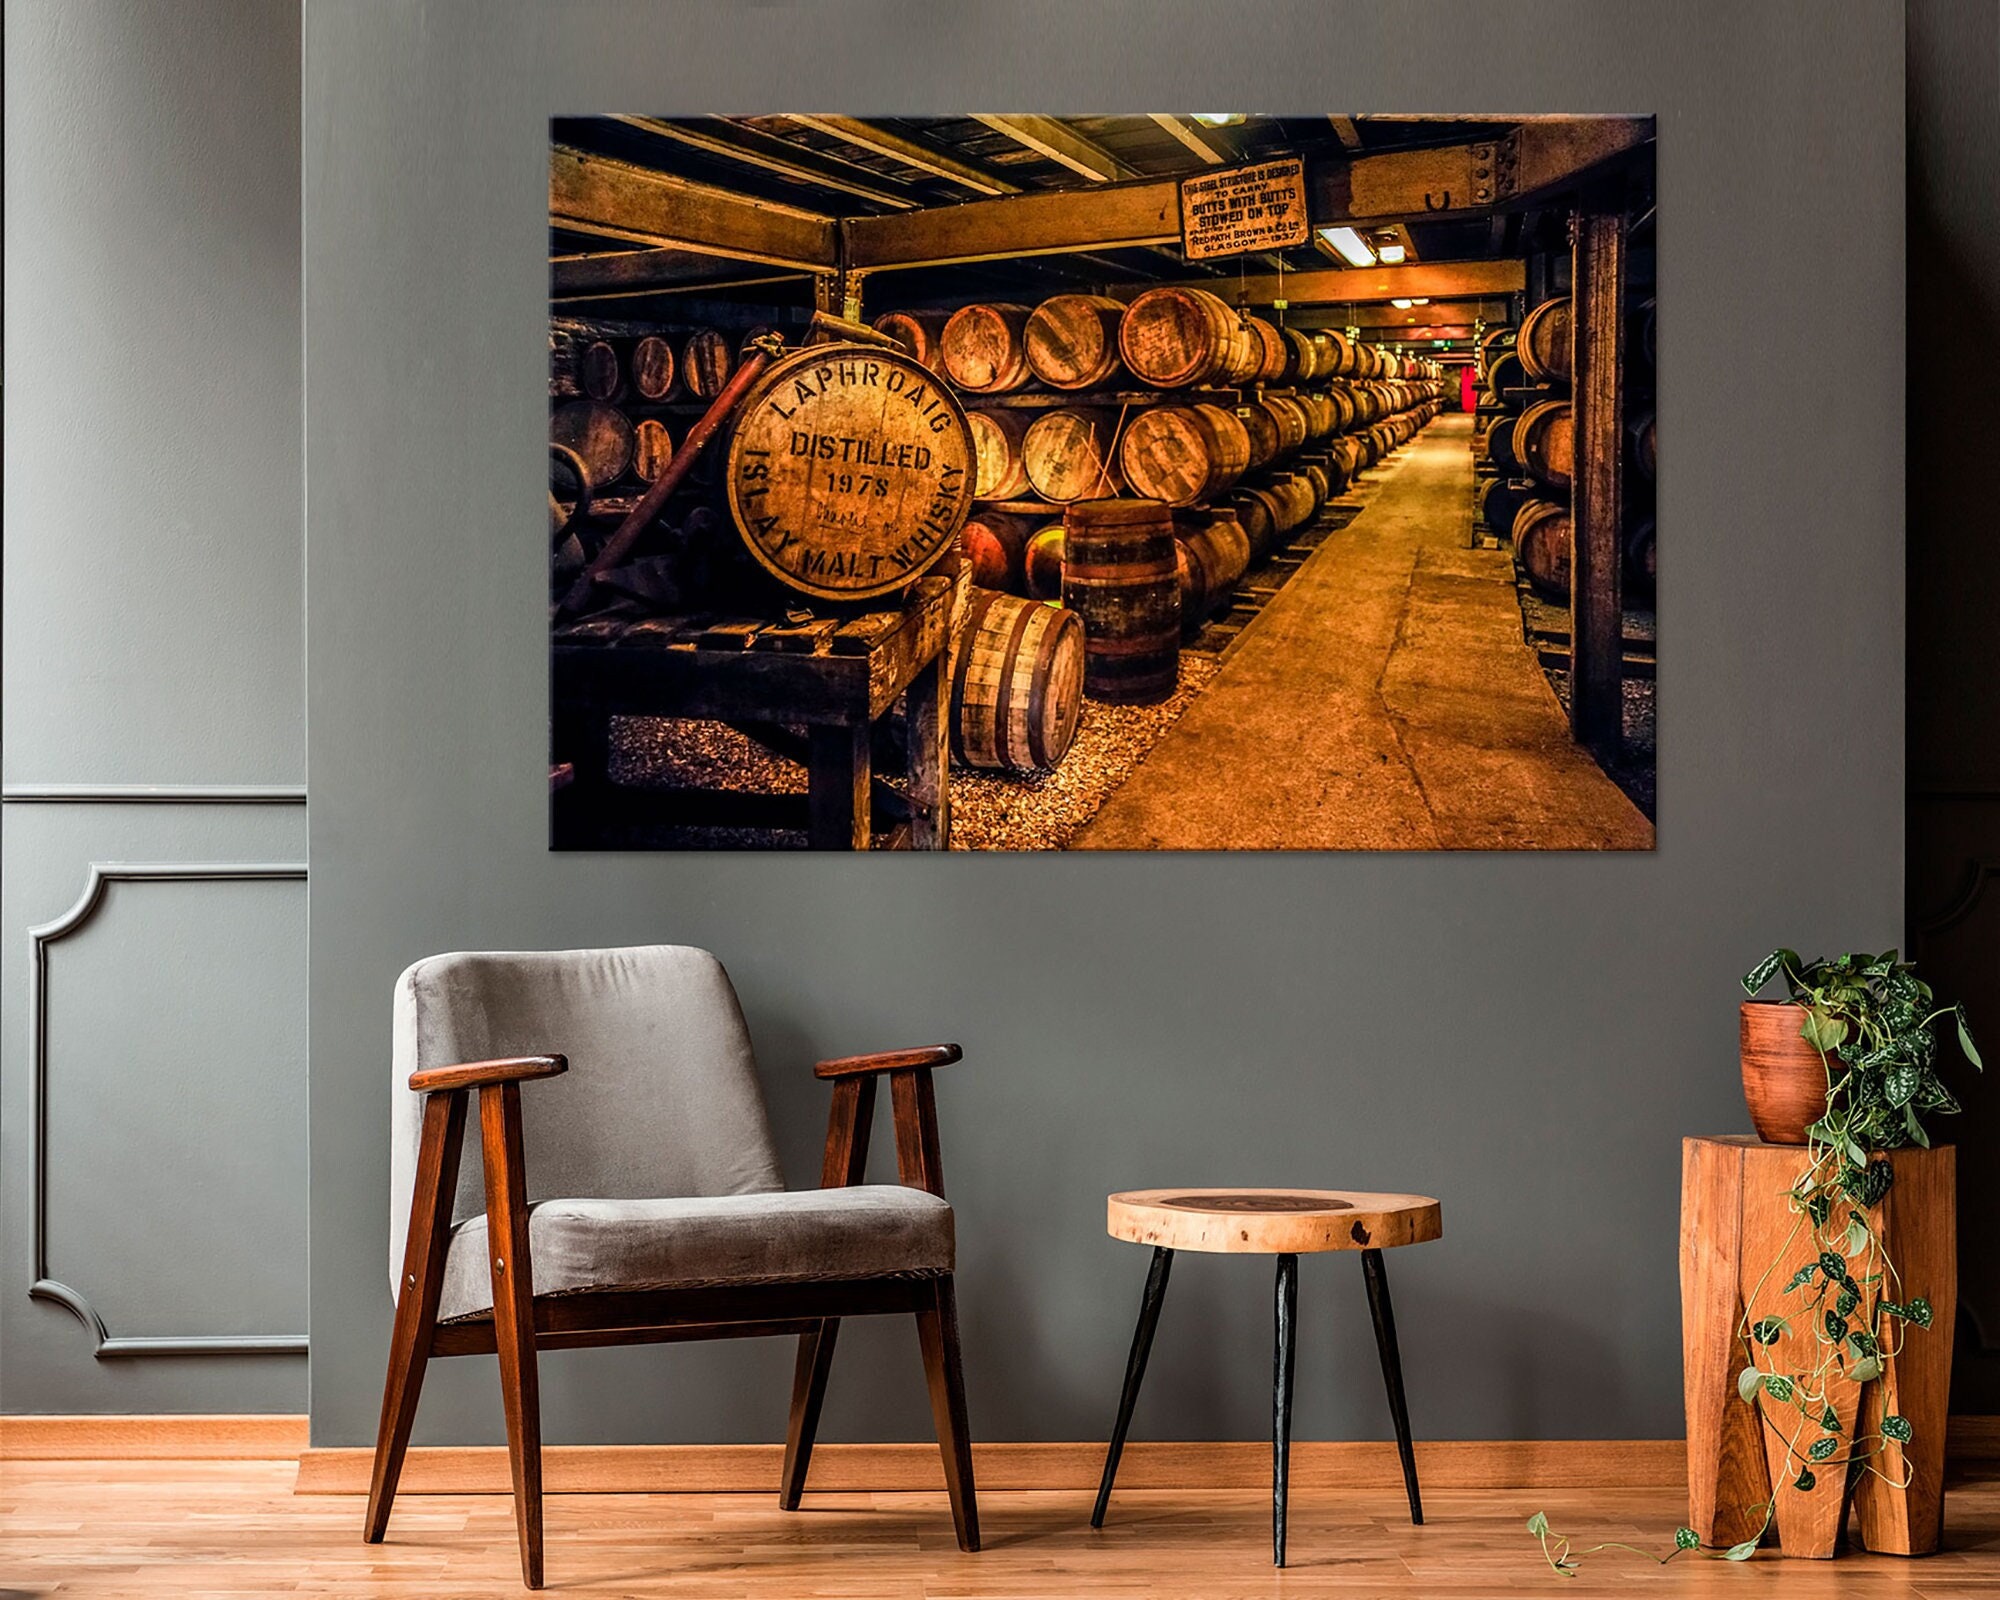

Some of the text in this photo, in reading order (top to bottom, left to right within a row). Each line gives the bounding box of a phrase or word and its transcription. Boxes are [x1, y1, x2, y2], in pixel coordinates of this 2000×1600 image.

[1257, 170, 1265, 181] IS
[1192, 187, 1296, 217] BUTTS WITH BUTTS
[1215, 182, 1269, 199] TO CARRY
[1198, 203, 1290, 228] STOWED ON TOP
[1192, 232, 1231, 246] REDPATH
[1233, 227, 1266, 240] BROWN
[1204, 237, 1257, 253] GLASGOW
[1271, 231, 1296, 243] 1937
[770, 362, 953, 434] LAPHROAIG
[790, 431, 932, 471] DISTILLED
[827, 472, 889, 497] 1978
[801, 549, 885, 580] MALT
[889, 463, 965, 571] WHISKY
